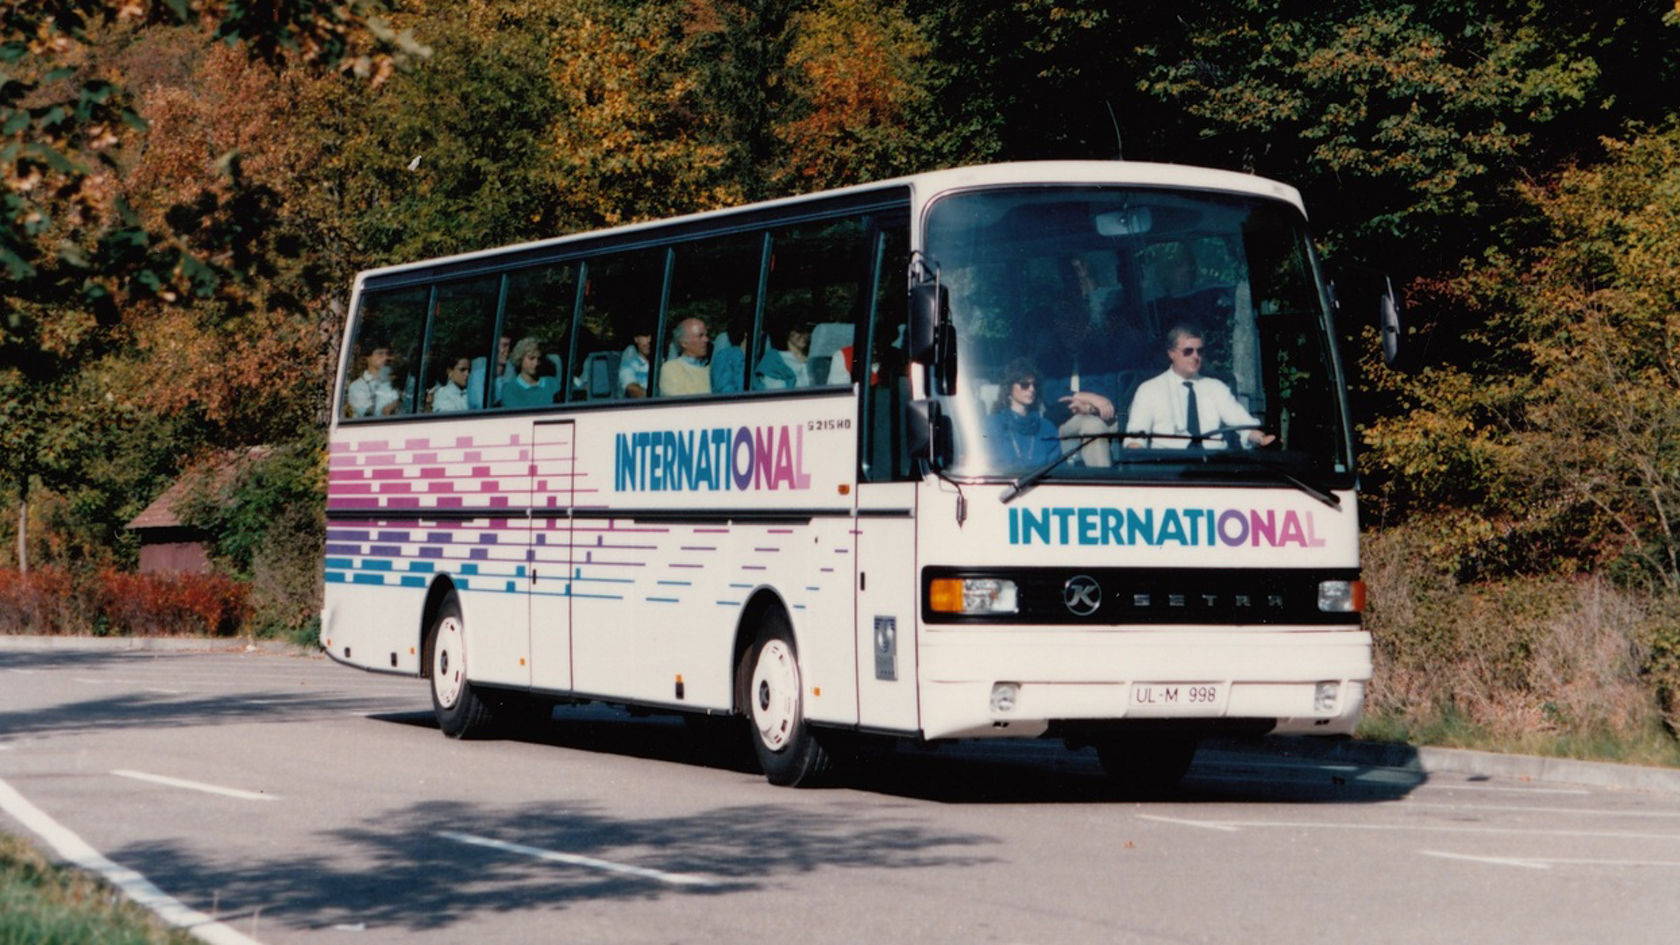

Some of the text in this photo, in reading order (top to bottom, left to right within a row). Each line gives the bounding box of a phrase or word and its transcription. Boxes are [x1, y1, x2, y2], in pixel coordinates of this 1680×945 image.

[614, 424, 811, 492] INTERNATIONAL
[1008, 507, 1326, 547] INTERNATIONAL
[1133, 594, 1283, 607] SETRA
[1188, 686, 1216, 703] 998
